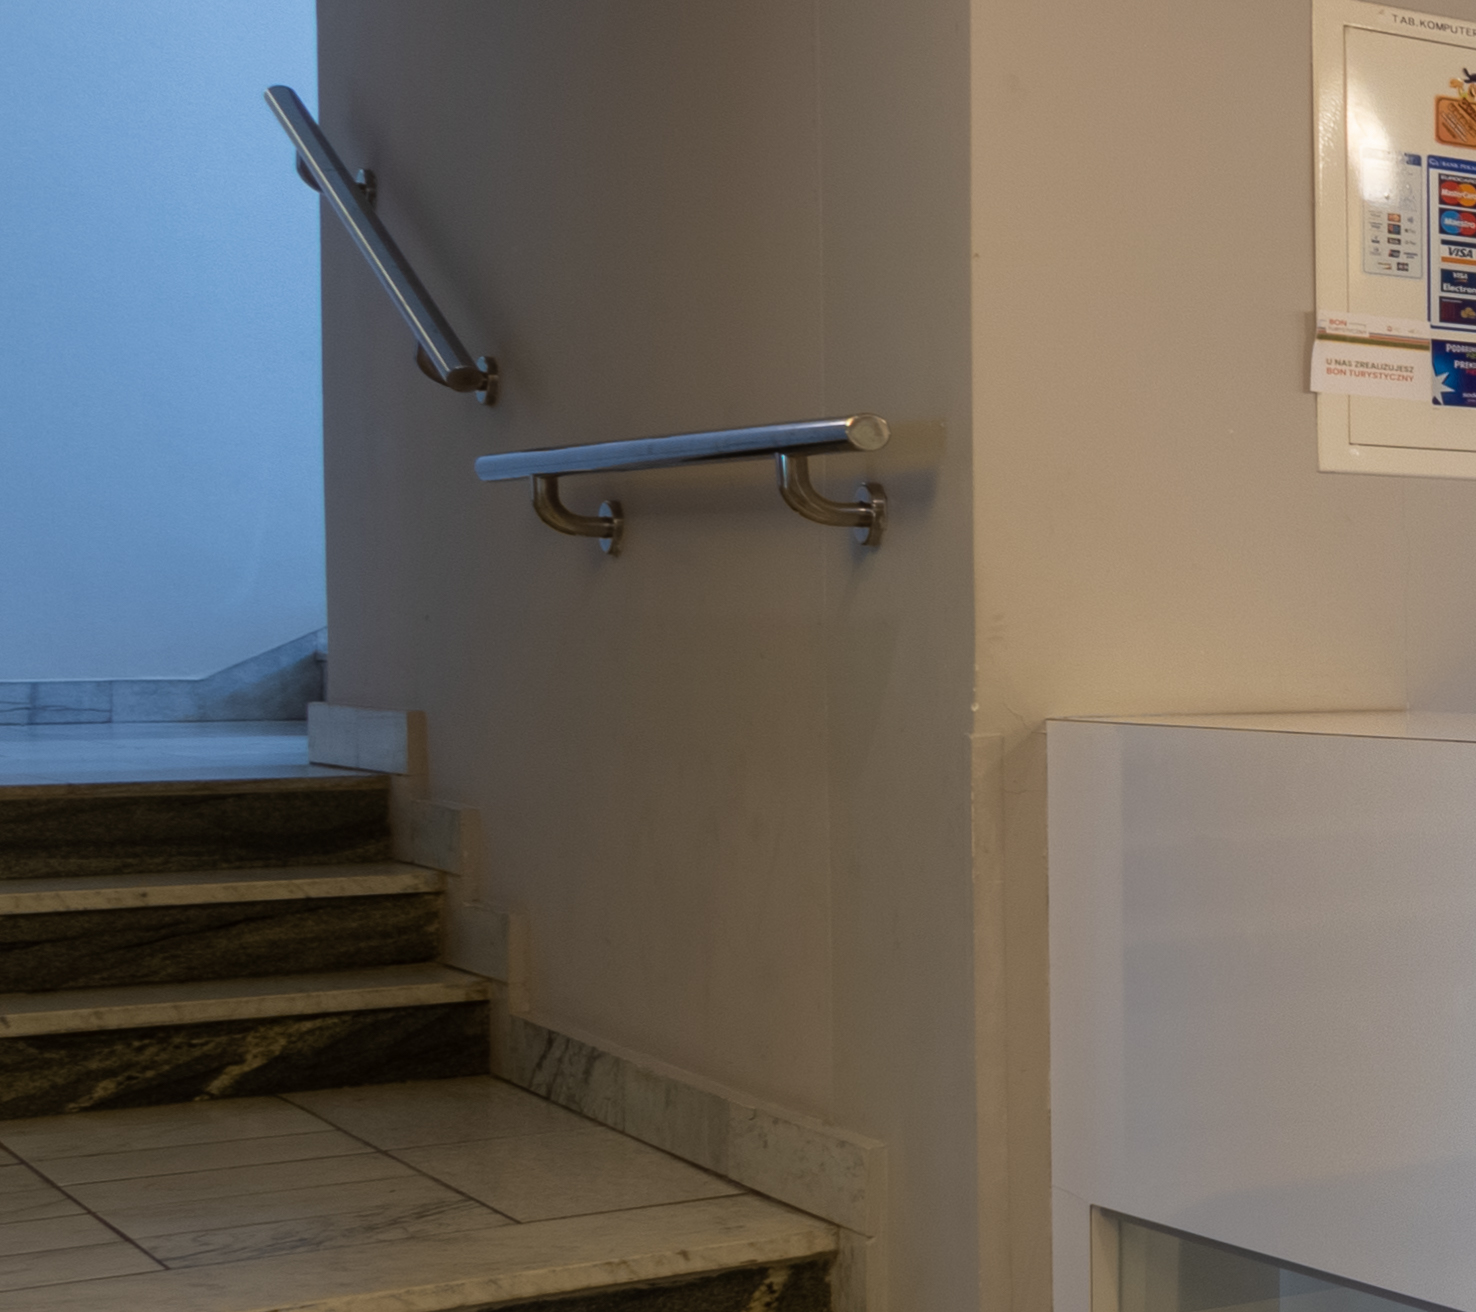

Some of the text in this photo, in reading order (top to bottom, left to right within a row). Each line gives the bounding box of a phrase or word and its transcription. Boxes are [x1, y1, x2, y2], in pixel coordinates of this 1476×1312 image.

[1447, 246, 1474, 259] VISA
[1334, 359, 1352, 367] NAS
[1326, 367, 1415, 383] BON TURYSTYCZNY
